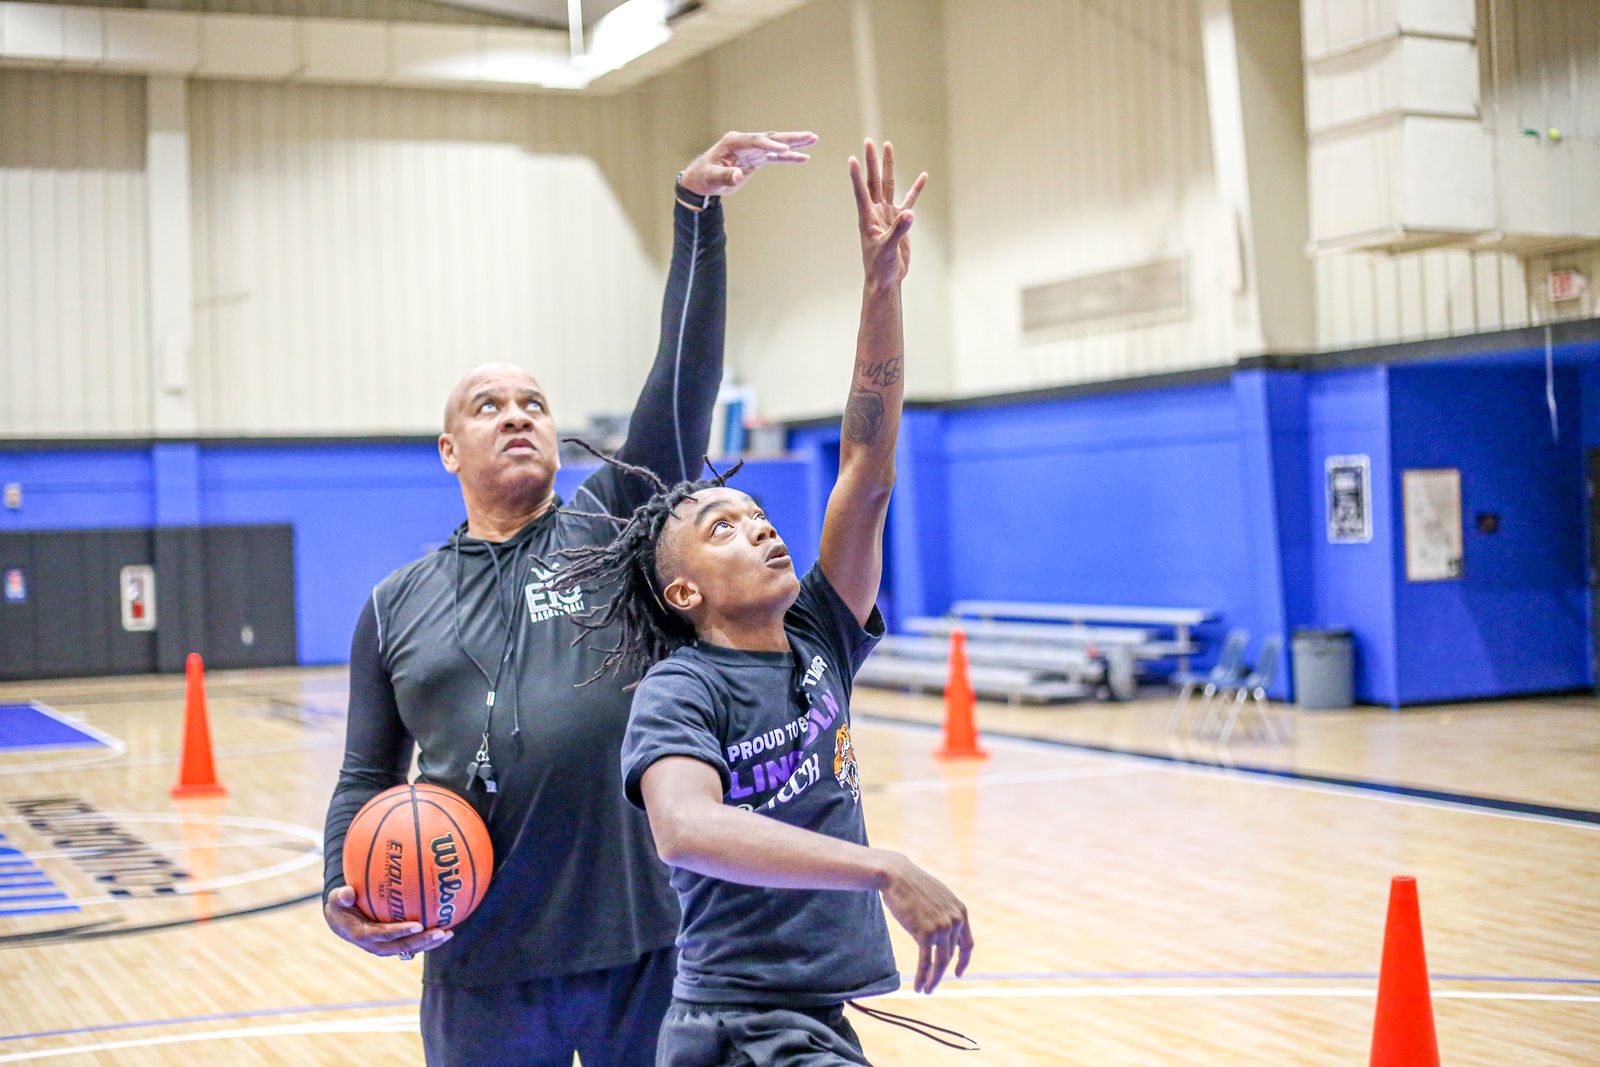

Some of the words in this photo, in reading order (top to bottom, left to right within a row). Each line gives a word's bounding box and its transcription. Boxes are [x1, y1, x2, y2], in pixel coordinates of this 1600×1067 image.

[727, 727, 786, 762] PROUD
[785, 721, 799, 741] TO
[430, 831, 464, 928] Wilson
